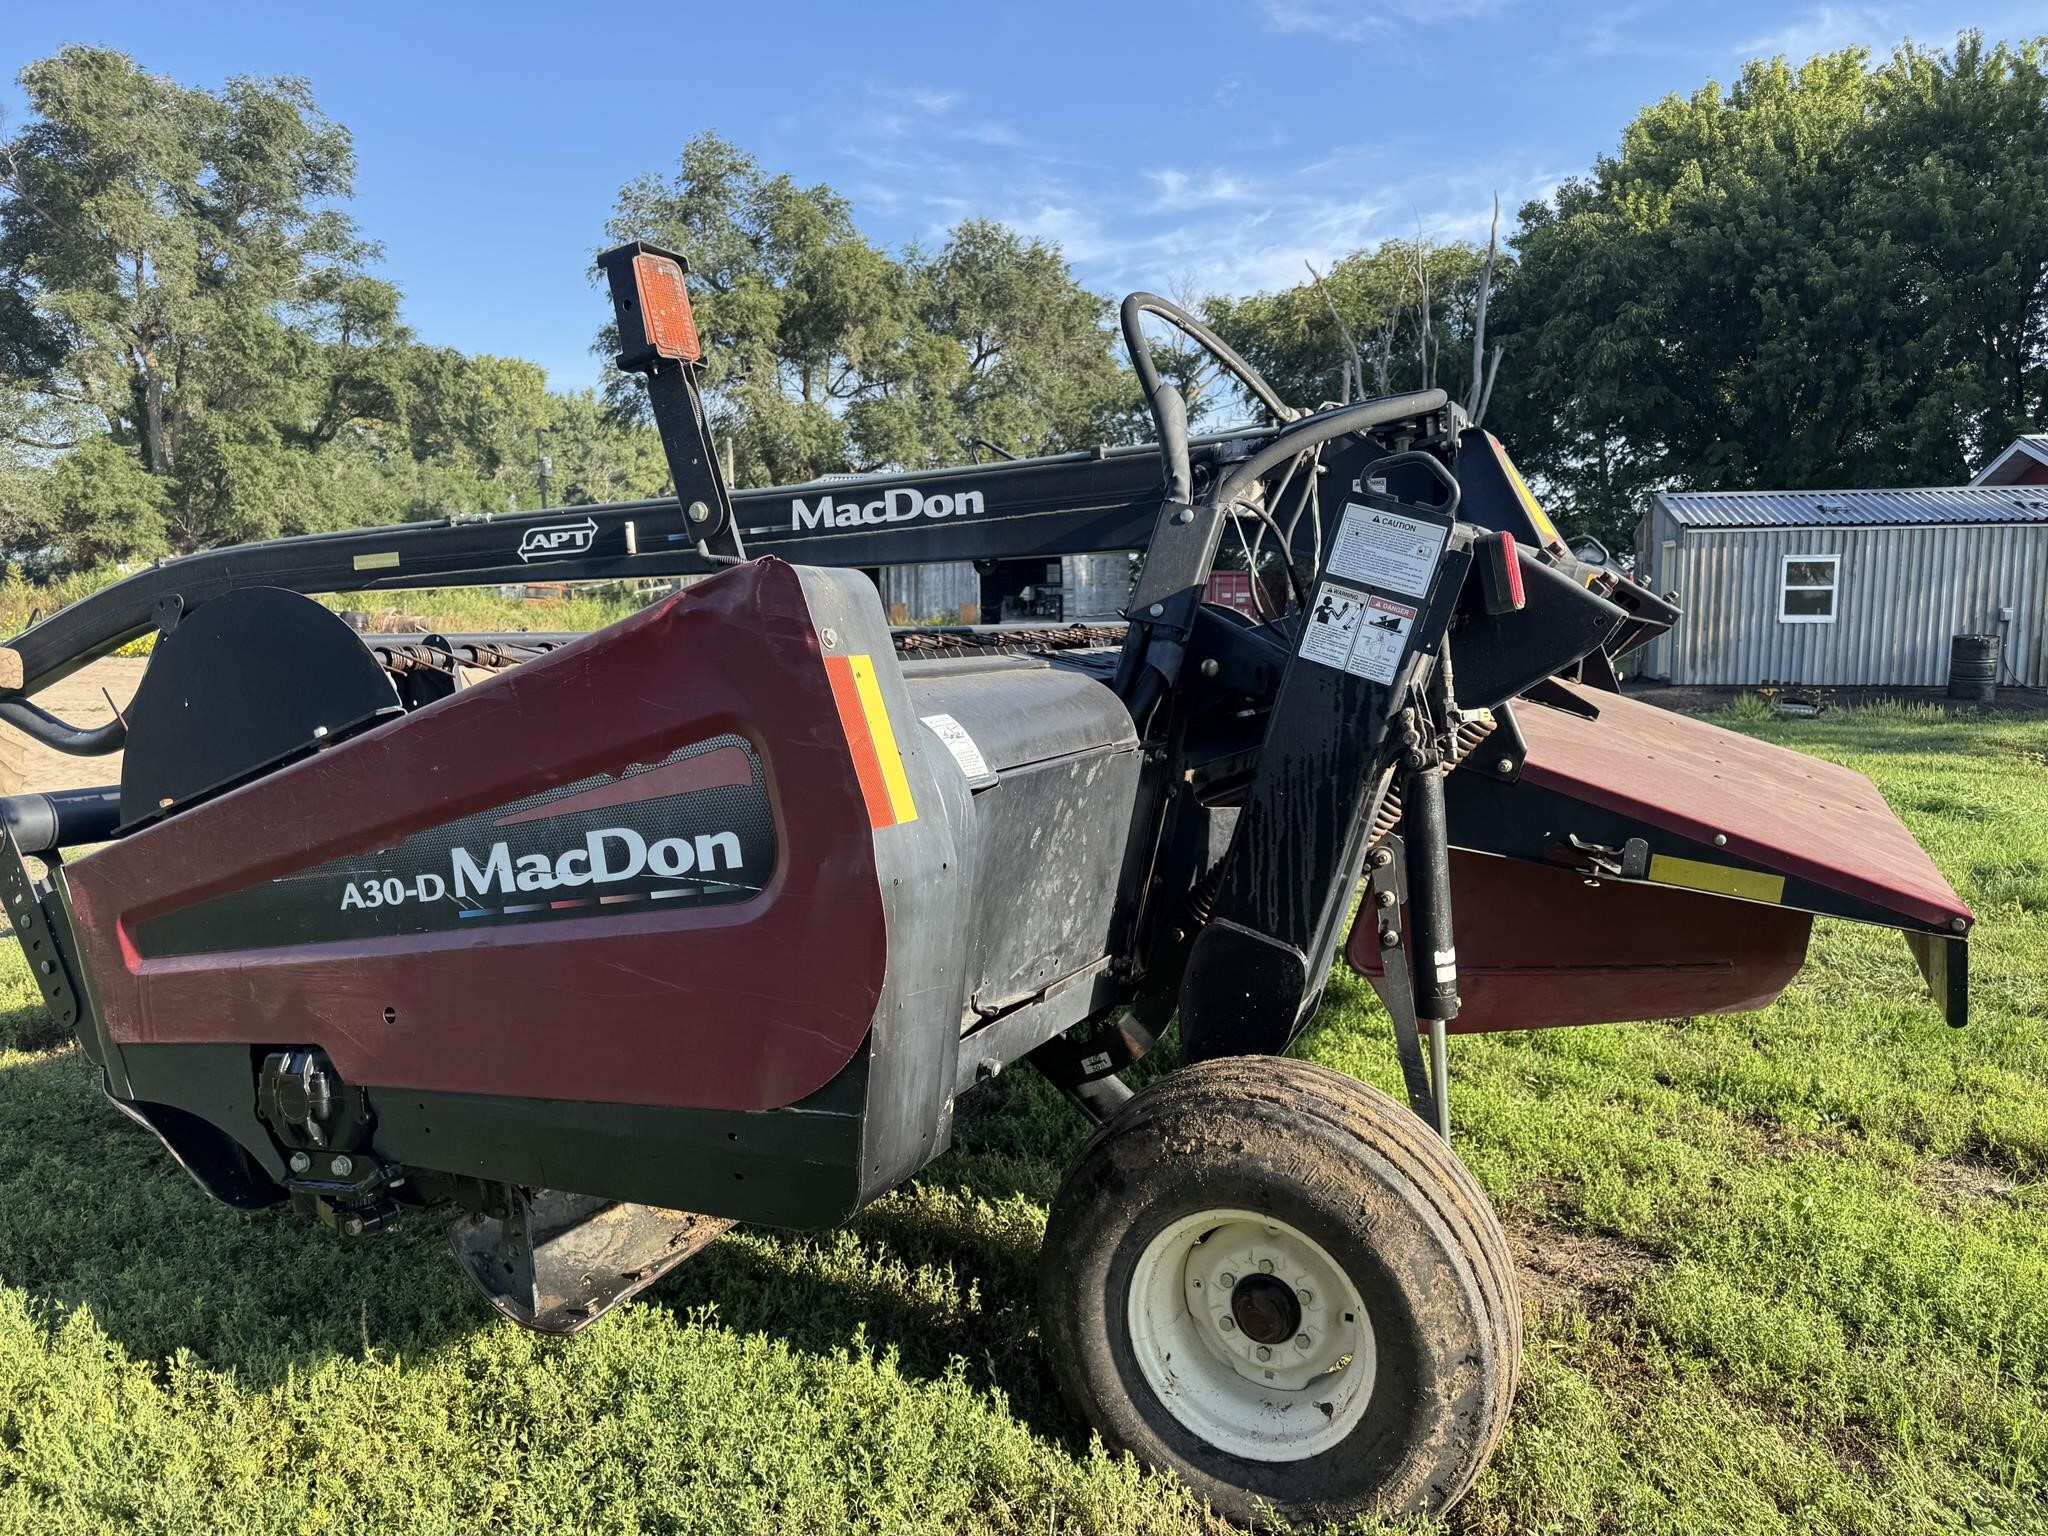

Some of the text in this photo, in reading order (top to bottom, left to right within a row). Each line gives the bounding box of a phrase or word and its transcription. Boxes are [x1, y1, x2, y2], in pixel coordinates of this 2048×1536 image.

[791, 487, 985, 531] MacDon
[1381, 516, 1417, 533] CAUTION
[530, 530, 590, 550] APT
[1333, 588, 1359, 601] WARNING
[1382, 601, 1410, 616] DANGER
[340, 826, 744, 912] A30-D MacDon
